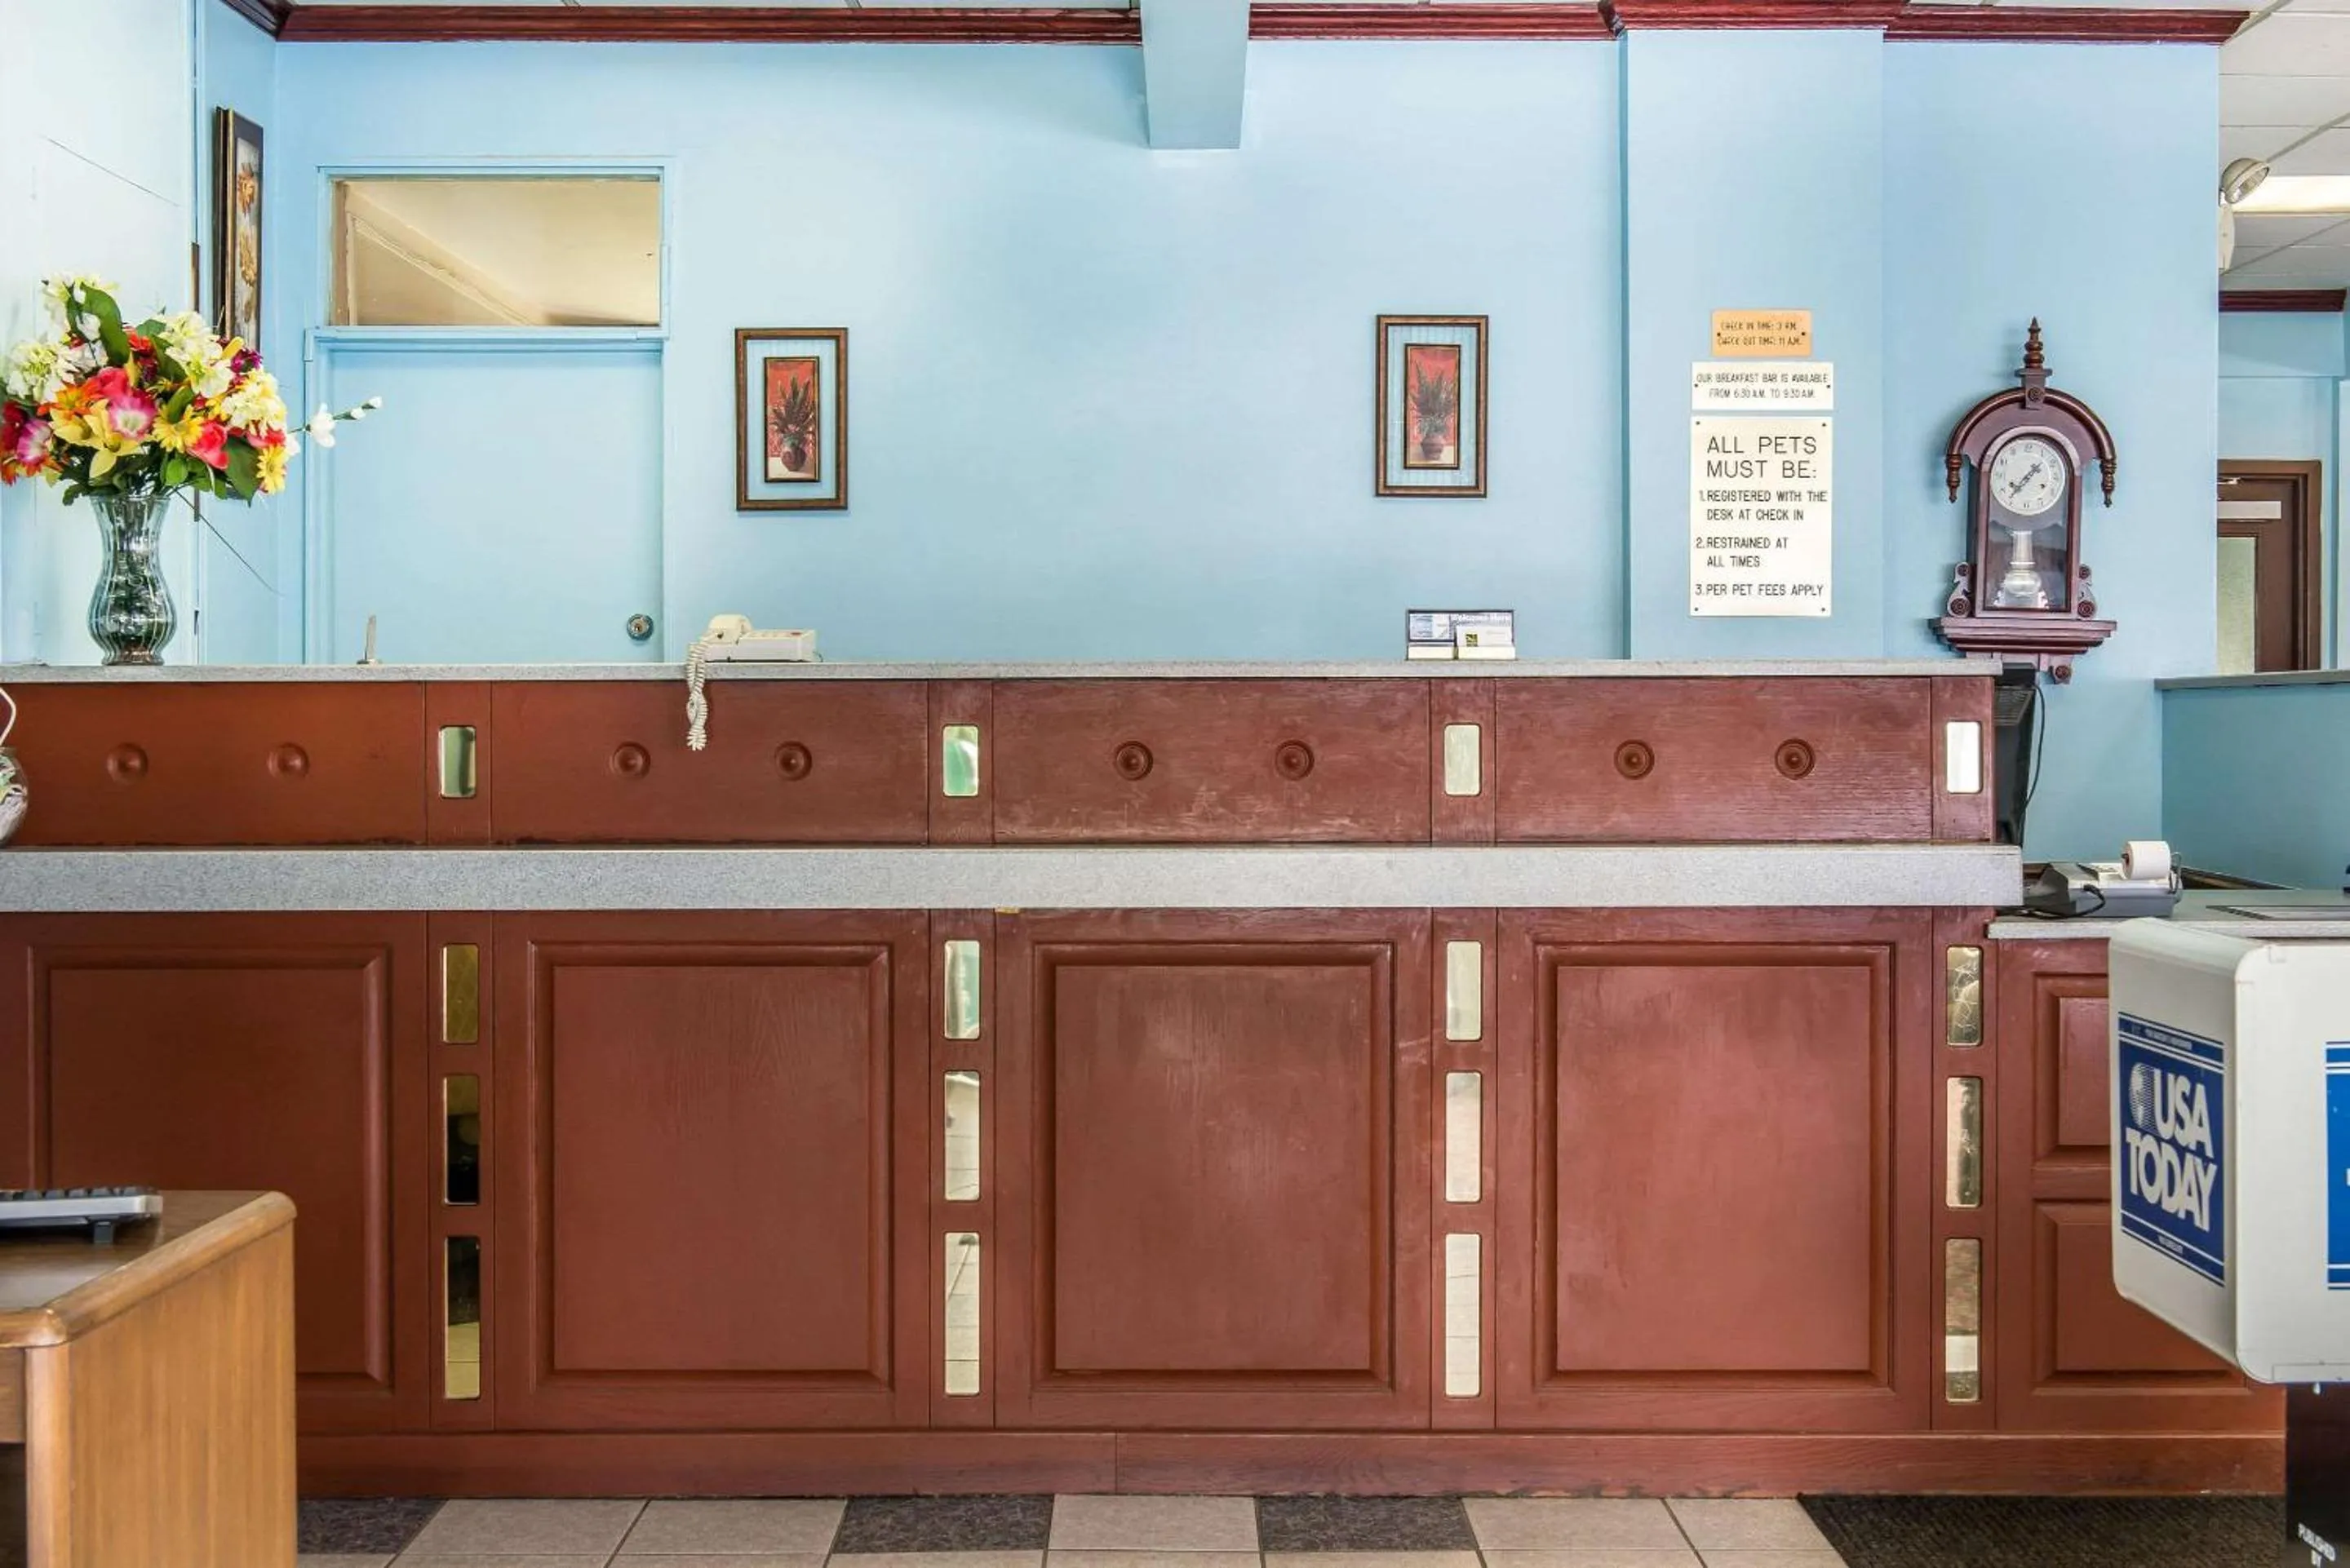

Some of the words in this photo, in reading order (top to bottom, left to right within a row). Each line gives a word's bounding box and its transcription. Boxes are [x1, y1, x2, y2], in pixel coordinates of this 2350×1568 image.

[1696, 372, 1713, 383] OUR
[1715, 372, 1759, 383] BREAKFAST
[1762, 372, 1778, 383] BAR
[1781, 372, 1789, 383] IS
[1791, 372, 1829, 383] AVAILABLE
[1709, 388, 1731, 399] FROM
[1770, 388, 1780, 399] TO
[1706, 435, 1745, 454] ALL
[1758, 435, 1817, 454] PETS
[1706, 459, 1768, 479] MUST
[1781, 459, 1817, 479] BE:
[1707, 490, 1771, 502] REGISTERED
[1776, 490, 1802, 502] WITH
[1807, 490, 1828, 502] THE
[1707, 509, 1734, 520] DESK
[1738, 509, 1752, 520] AT
[1755, 509, 1789, 520] CHECK
[1793, 509, 1804, 520] IN
[1706, 537, 1771, 549] RESTRAINED
[1776, 537, 1789, 549] AT
[1706, 556, 1725, 567] ALL
[1729, 556, 1761, 567] TIMES
[1706, 584, 1728, 596] PER
[1732, 584, 1754, 596] PET
[1758, 584, 1786, 596] FEES
[1790, 584, 1825, 596] APPLY
[2153, 1068, 2215, 1159] USA
[2126, 1127, 2218, 1233] TODAY
